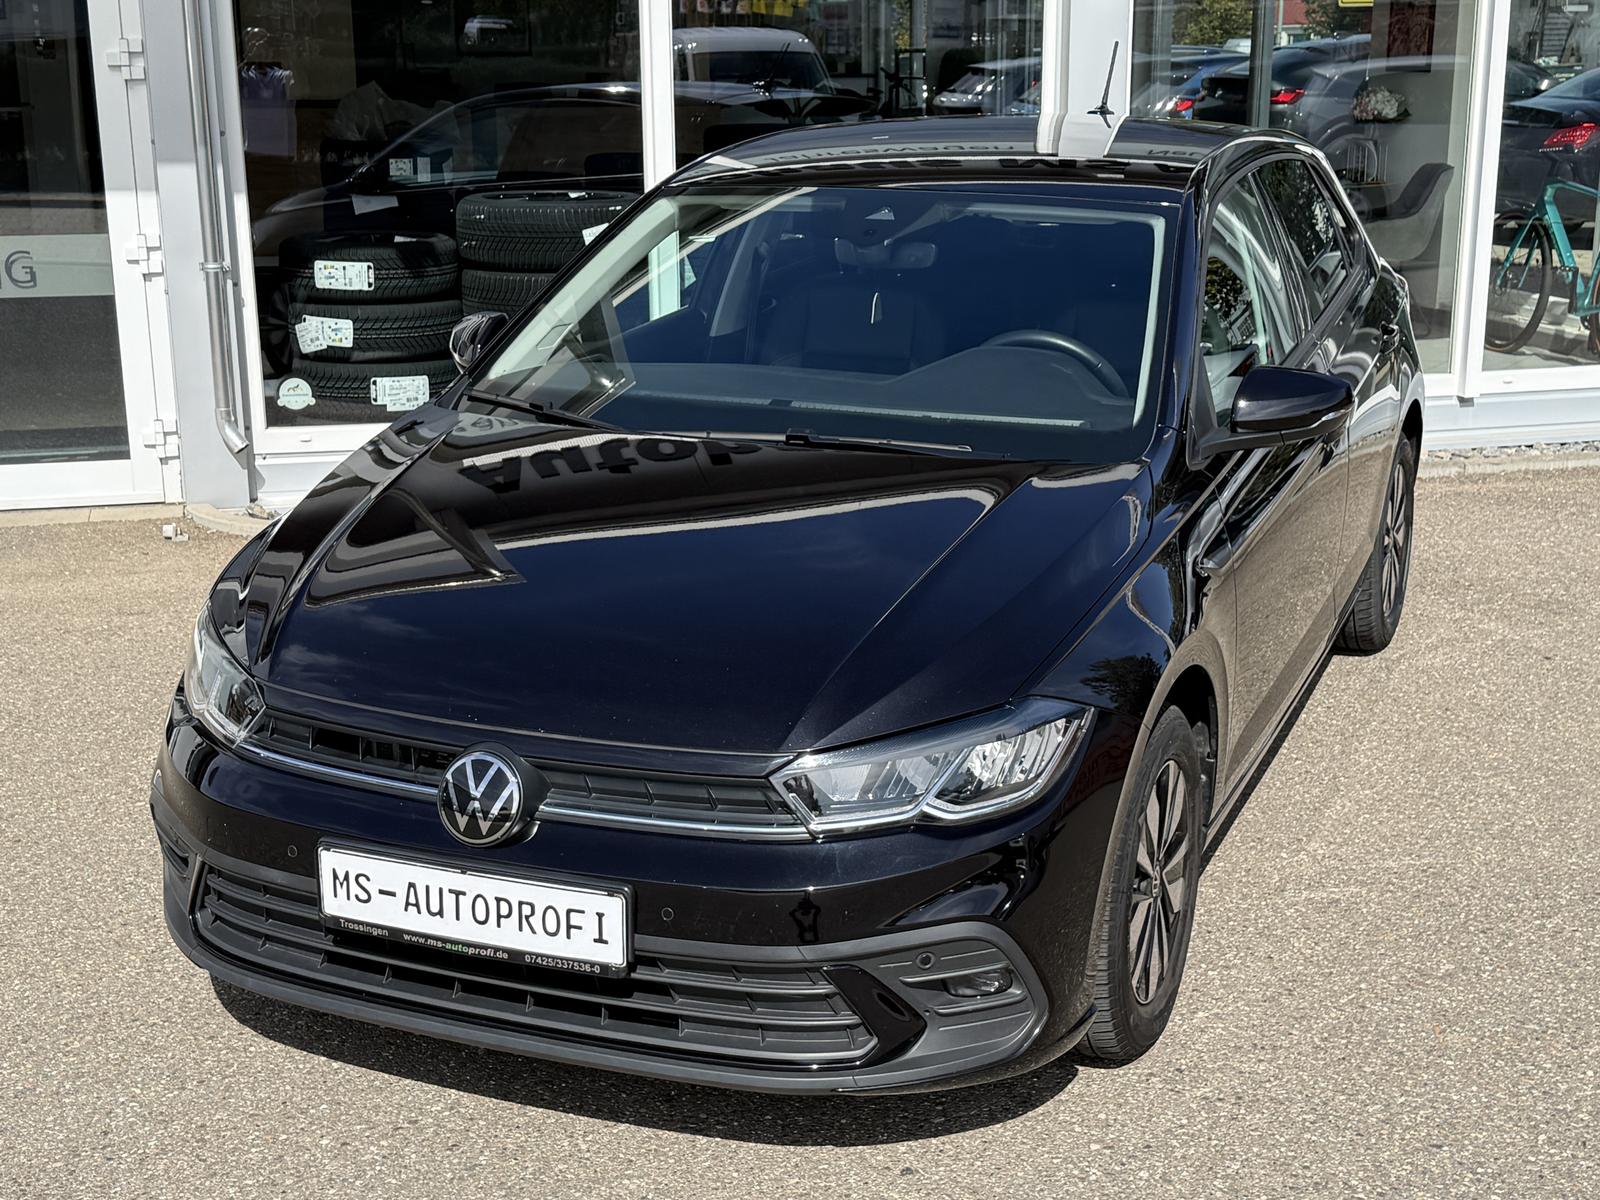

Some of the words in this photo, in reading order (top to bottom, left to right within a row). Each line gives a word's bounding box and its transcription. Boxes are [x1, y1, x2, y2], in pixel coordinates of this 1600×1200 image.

[330, 867, 610, 945] MS-AUTOPROFI
[339, 918, 389, 937] Trossingen
[403, 932, 510, 960] www.ms-autoprofi.de
[524, 954, 601, 974] 07425/337536-0
